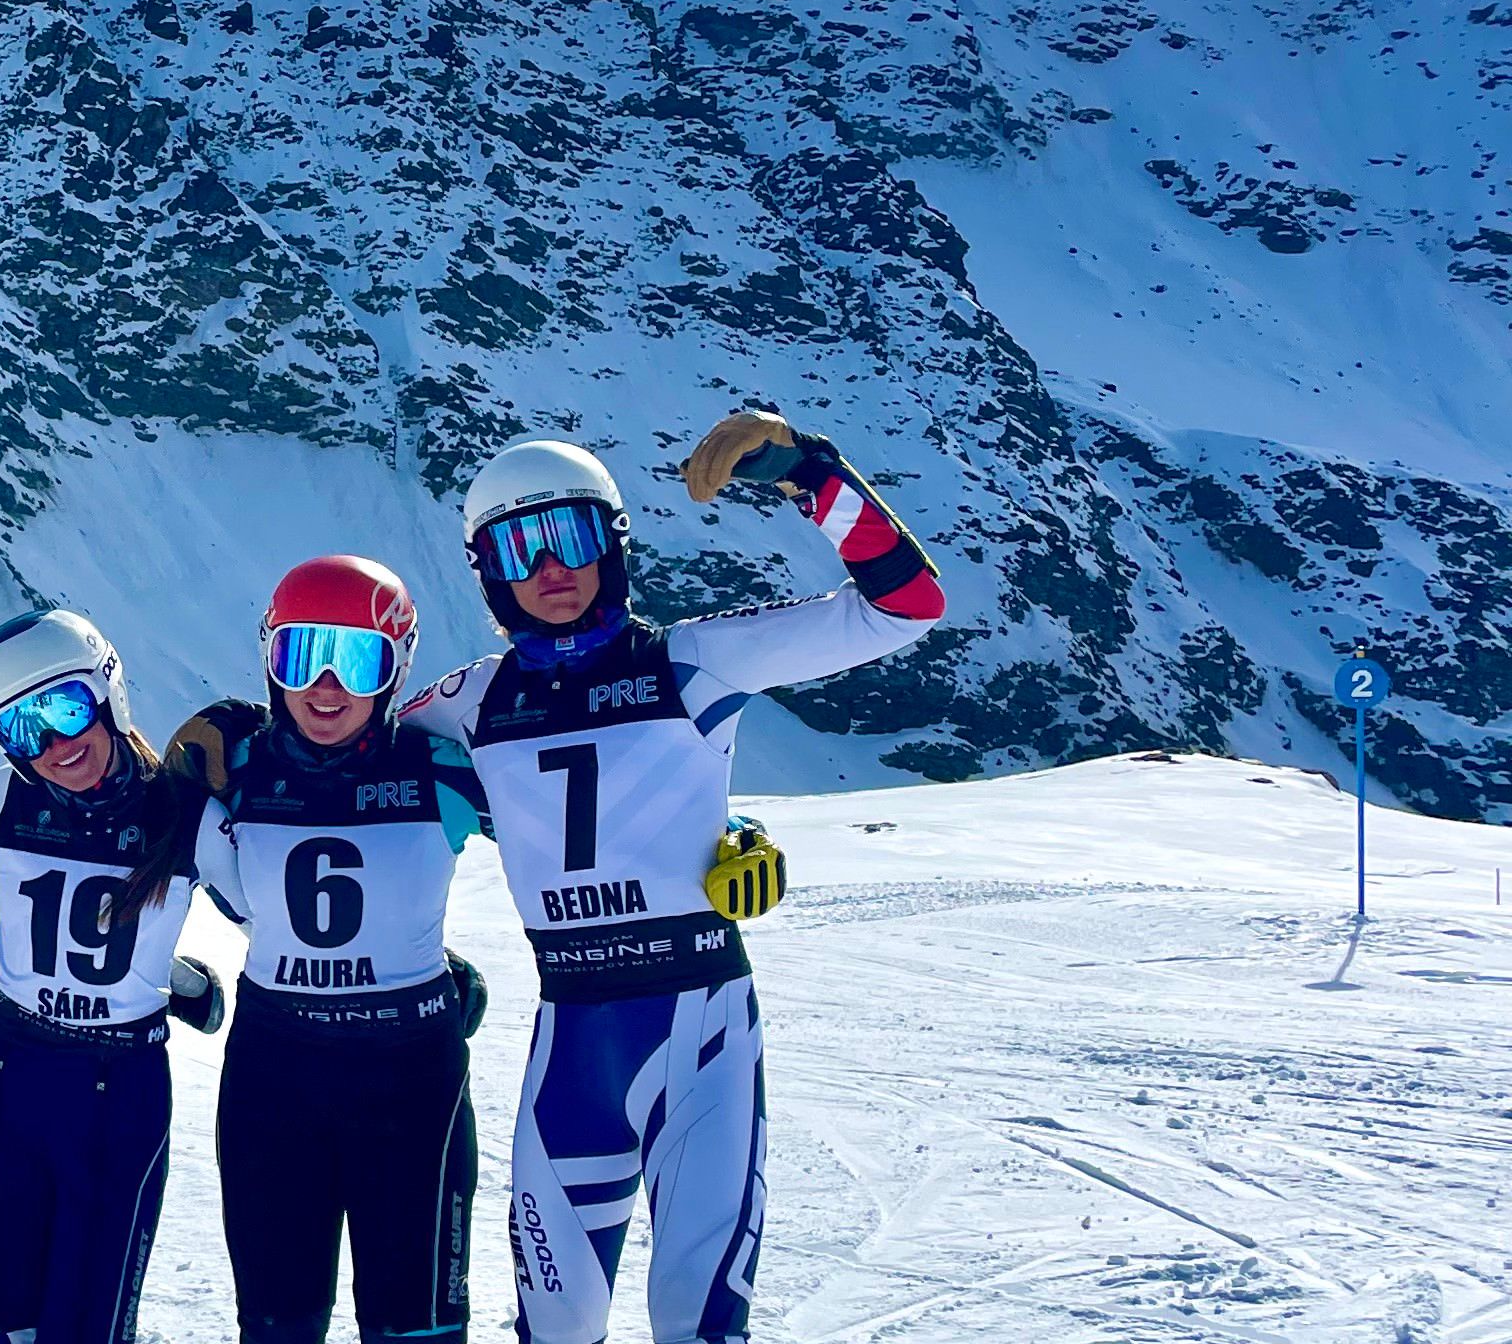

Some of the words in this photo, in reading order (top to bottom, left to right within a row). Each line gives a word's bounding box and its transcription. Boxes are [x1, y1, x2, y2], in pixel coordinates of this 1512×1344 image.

[589, 675, 660, 713] PRE
[1350, 669, 1373, 698] 2
[357, 780, 421, 811] PRE
[537, 742, 599, 872] 7
[285, 837, 364, 949] 6
[541, 879, 648, 923] BEDNA
[19, 869, 141, 986] 19
[695, 928, 726, 952] HH
[274, 955, 377, 989] LAURA
[38, 987, 111, 1020] SÁRA
[418, 993, 446, 1018] HH
